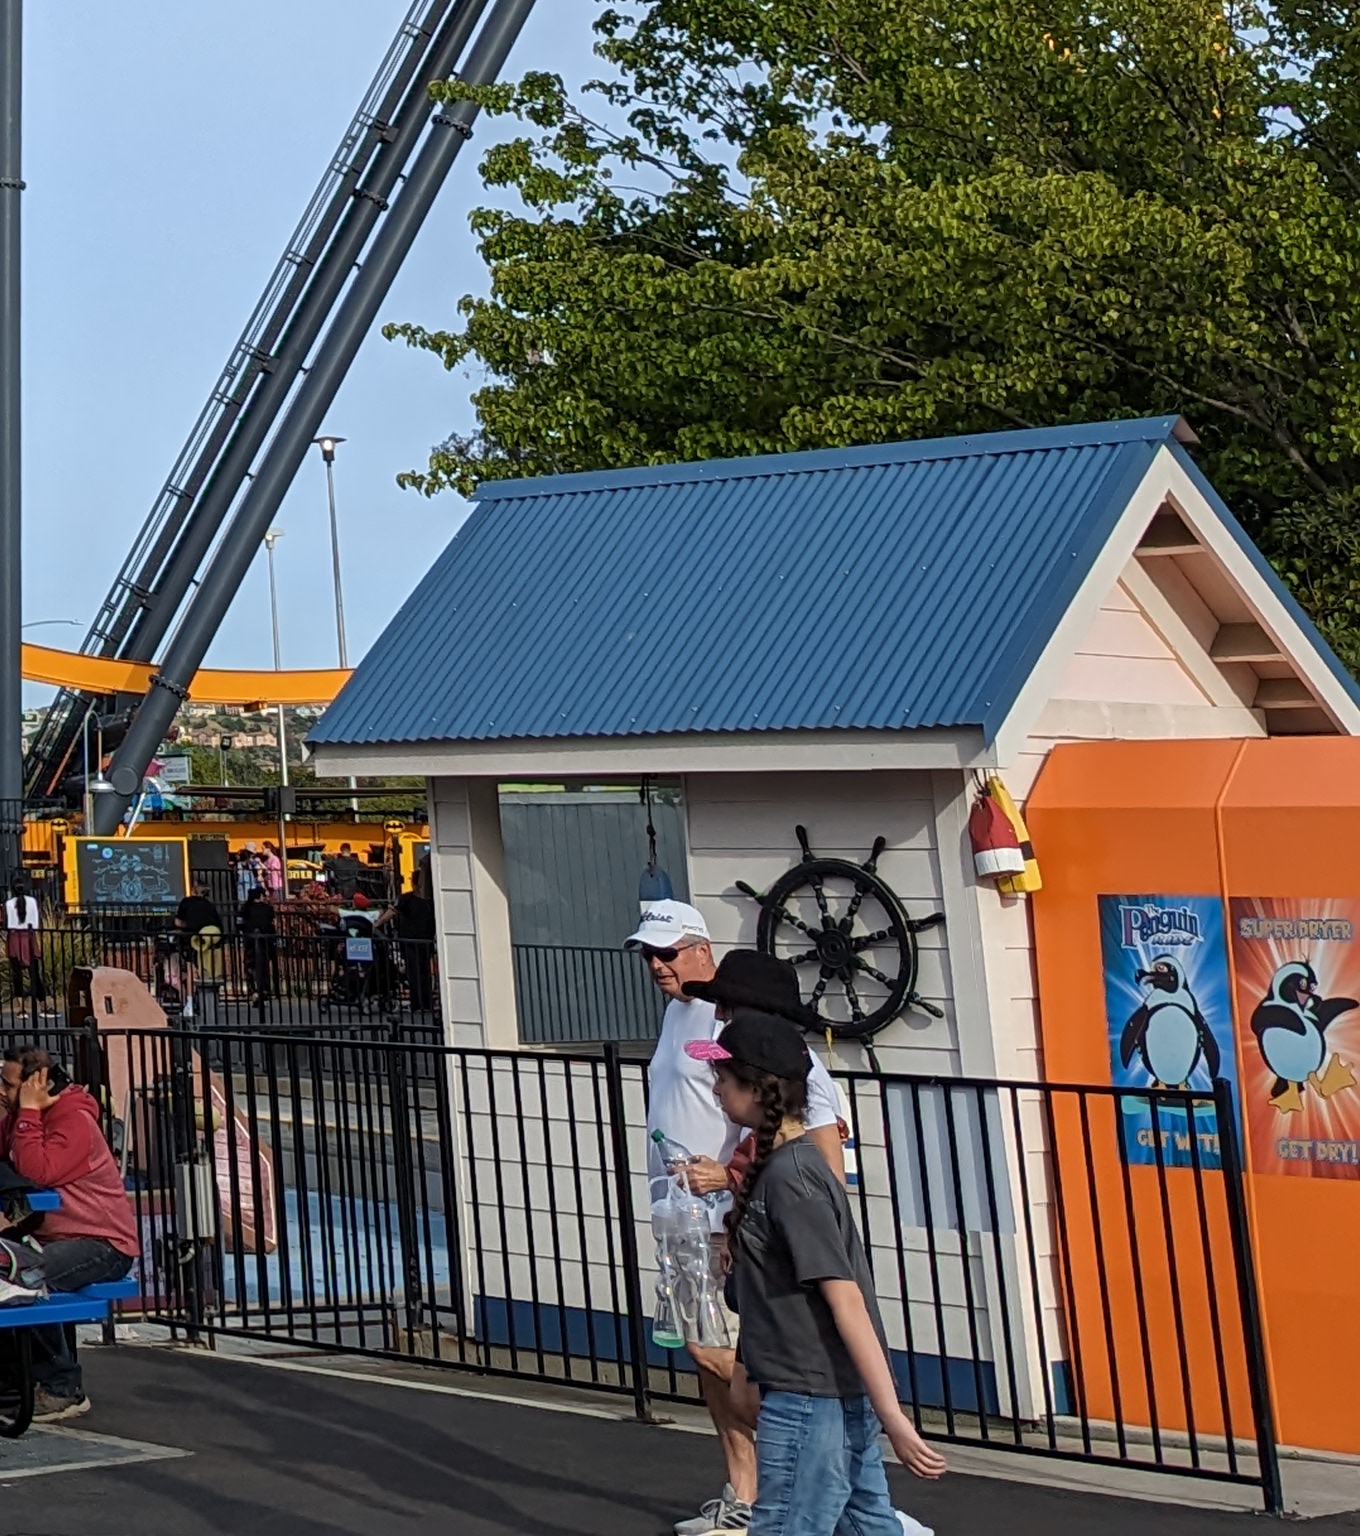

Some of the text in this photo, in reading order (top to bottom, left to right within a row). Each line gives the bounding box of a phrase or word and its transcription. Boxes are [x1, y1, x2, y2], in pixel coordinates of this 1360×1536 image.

[1120, 906, 1201, 948] Penguin
[1240, 919, 1353, 940] SUPER DRYER
[1174, 1132, 1220, 1155] WT!
[1278, 1139, 1359, 1164] GET DRY!
